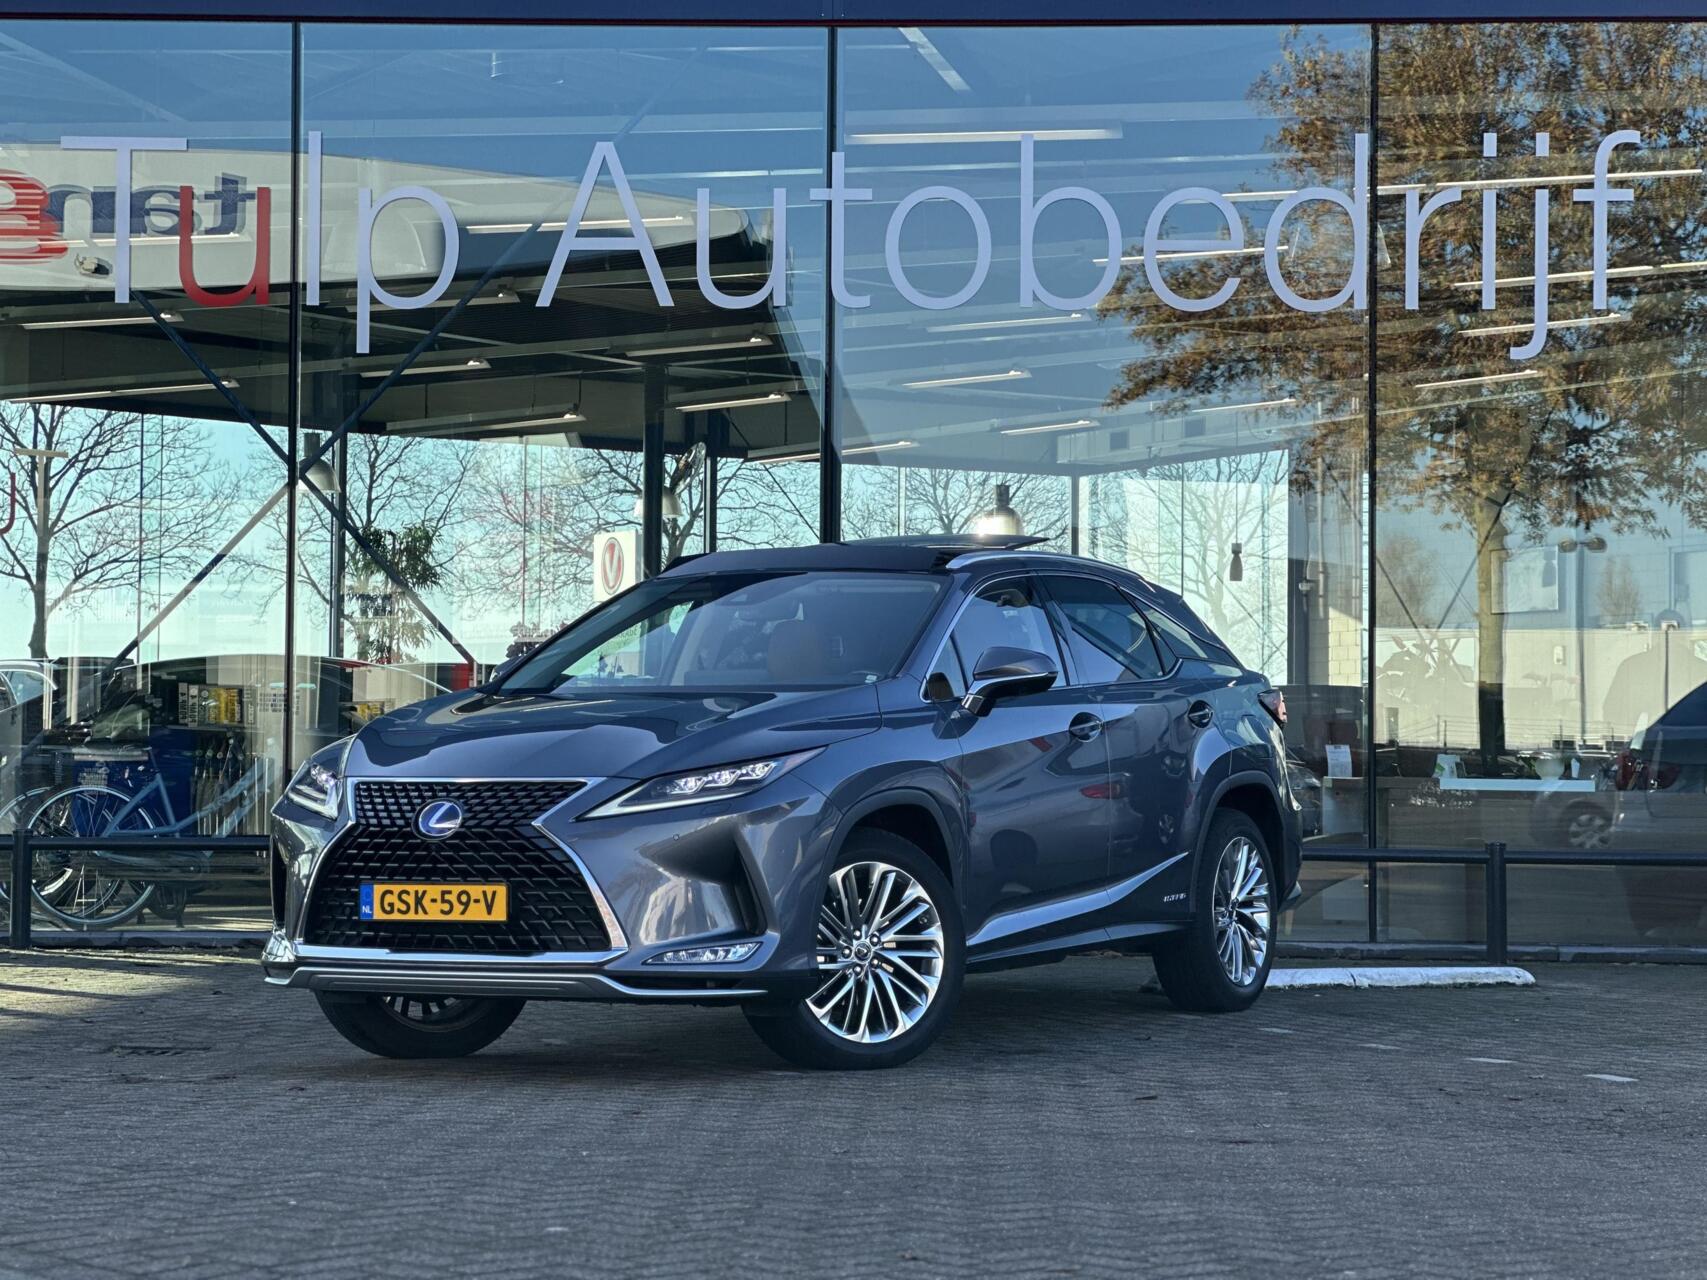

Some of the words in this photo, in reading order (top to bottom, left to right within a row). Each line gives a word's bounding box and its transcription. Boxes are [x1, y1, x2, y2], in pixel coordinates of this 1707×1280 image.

[61, 131, 459, 354] Tulp
[535, 130, 1640, 360] Autobedrijf
[380, 889, 497, 916] GSK-59-V
